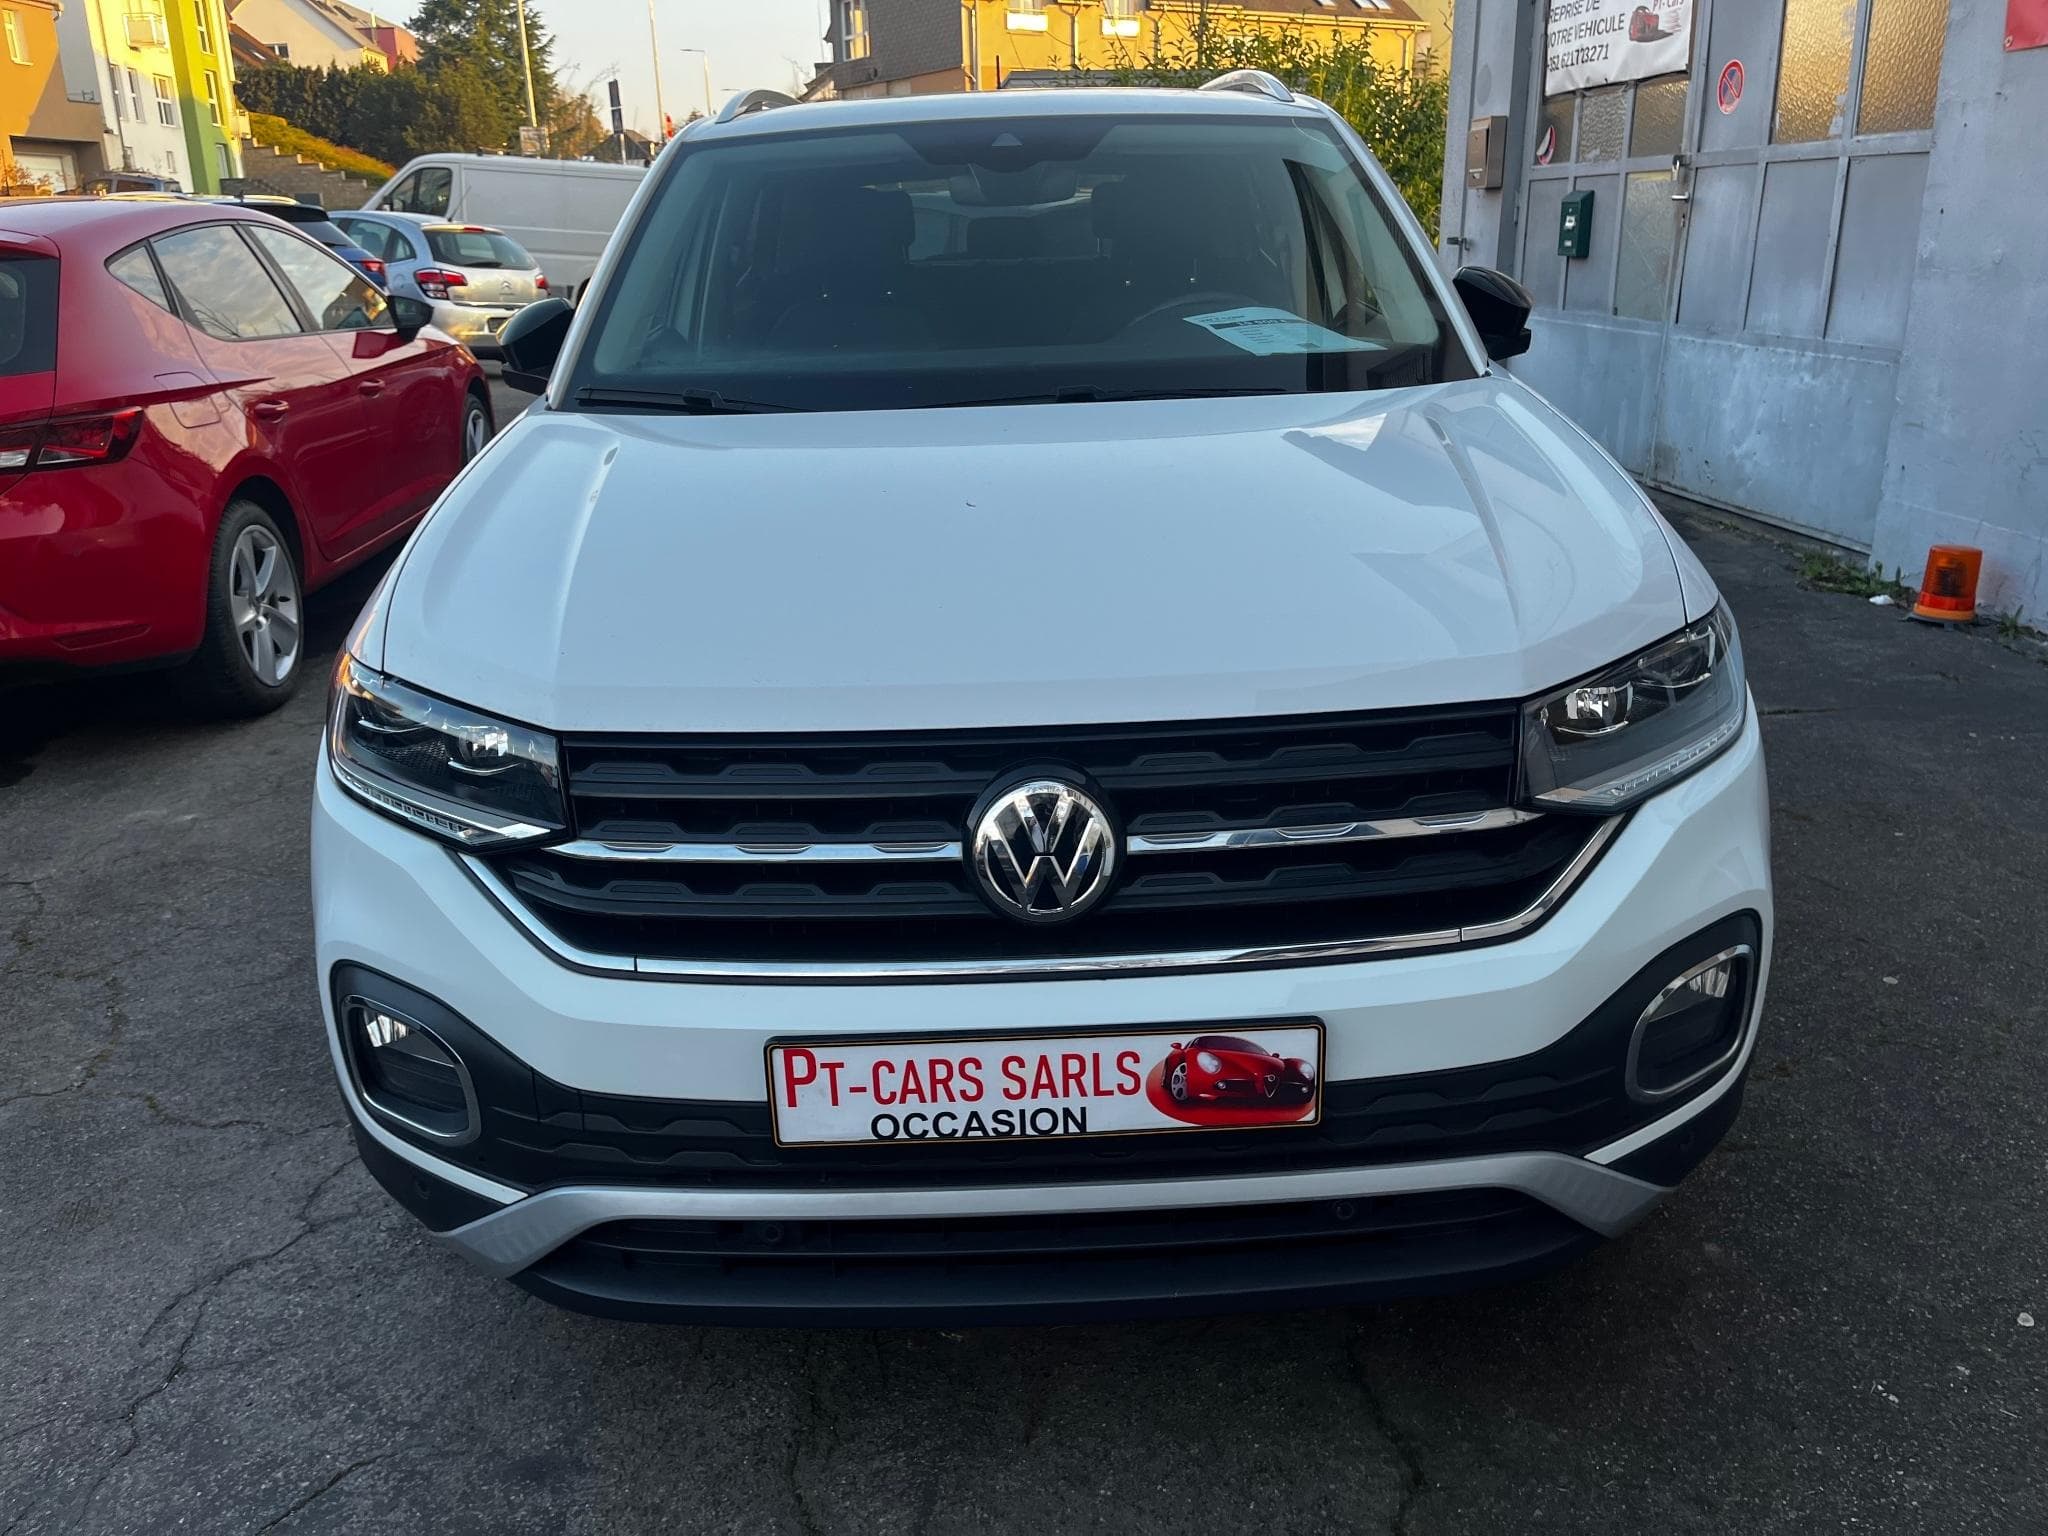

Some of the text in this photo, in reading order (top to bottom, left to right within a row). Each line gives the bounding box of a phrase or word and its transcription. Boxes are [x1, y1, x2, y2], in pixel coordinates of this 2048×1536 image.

[783, 1047, 1142, 1108] PT-CARS SARLS
[870, 1106, 1088, 1141] OCCASION
